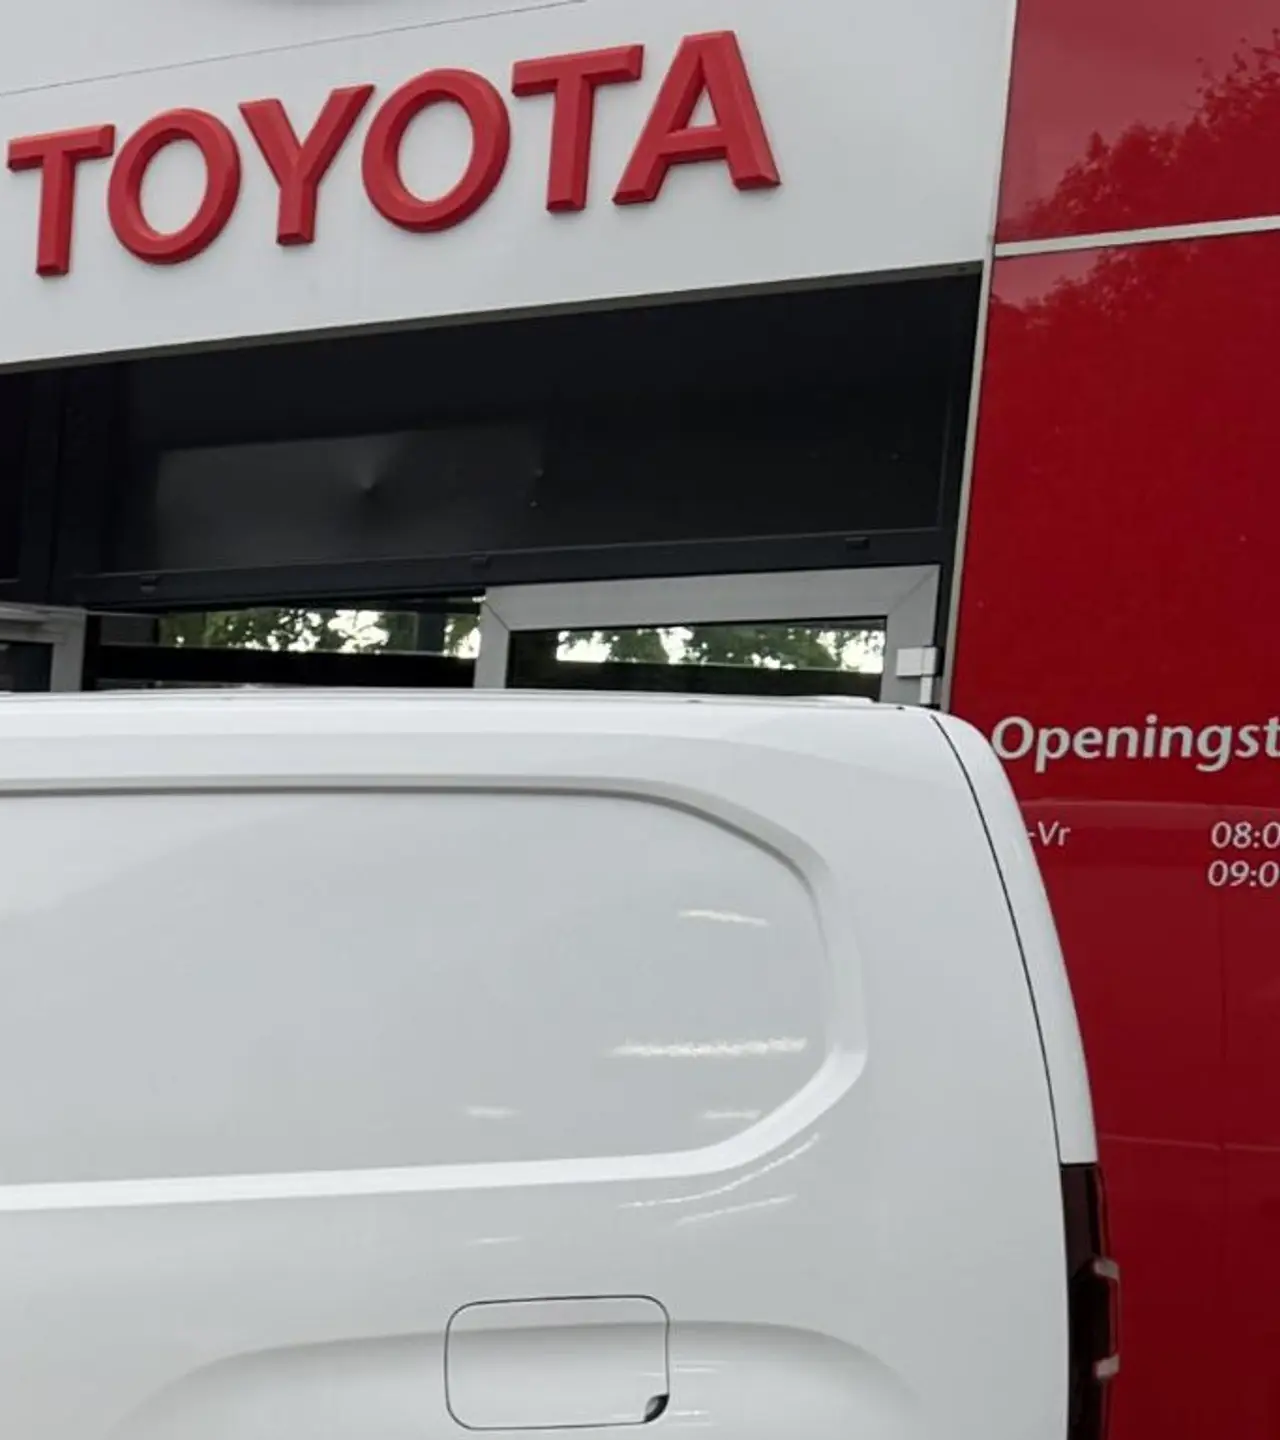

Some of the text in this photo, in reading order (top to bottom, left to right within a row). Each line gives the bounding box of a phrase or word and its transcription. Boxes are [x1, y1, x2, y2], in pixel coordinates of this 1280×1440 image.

[7, 31, 781, 277] TOYOTA
[991, 714, 1280, 773] Openingst
[1211, 821, 1280, 849] 08:0
[1208, 860, 1280, 888] 09:0
